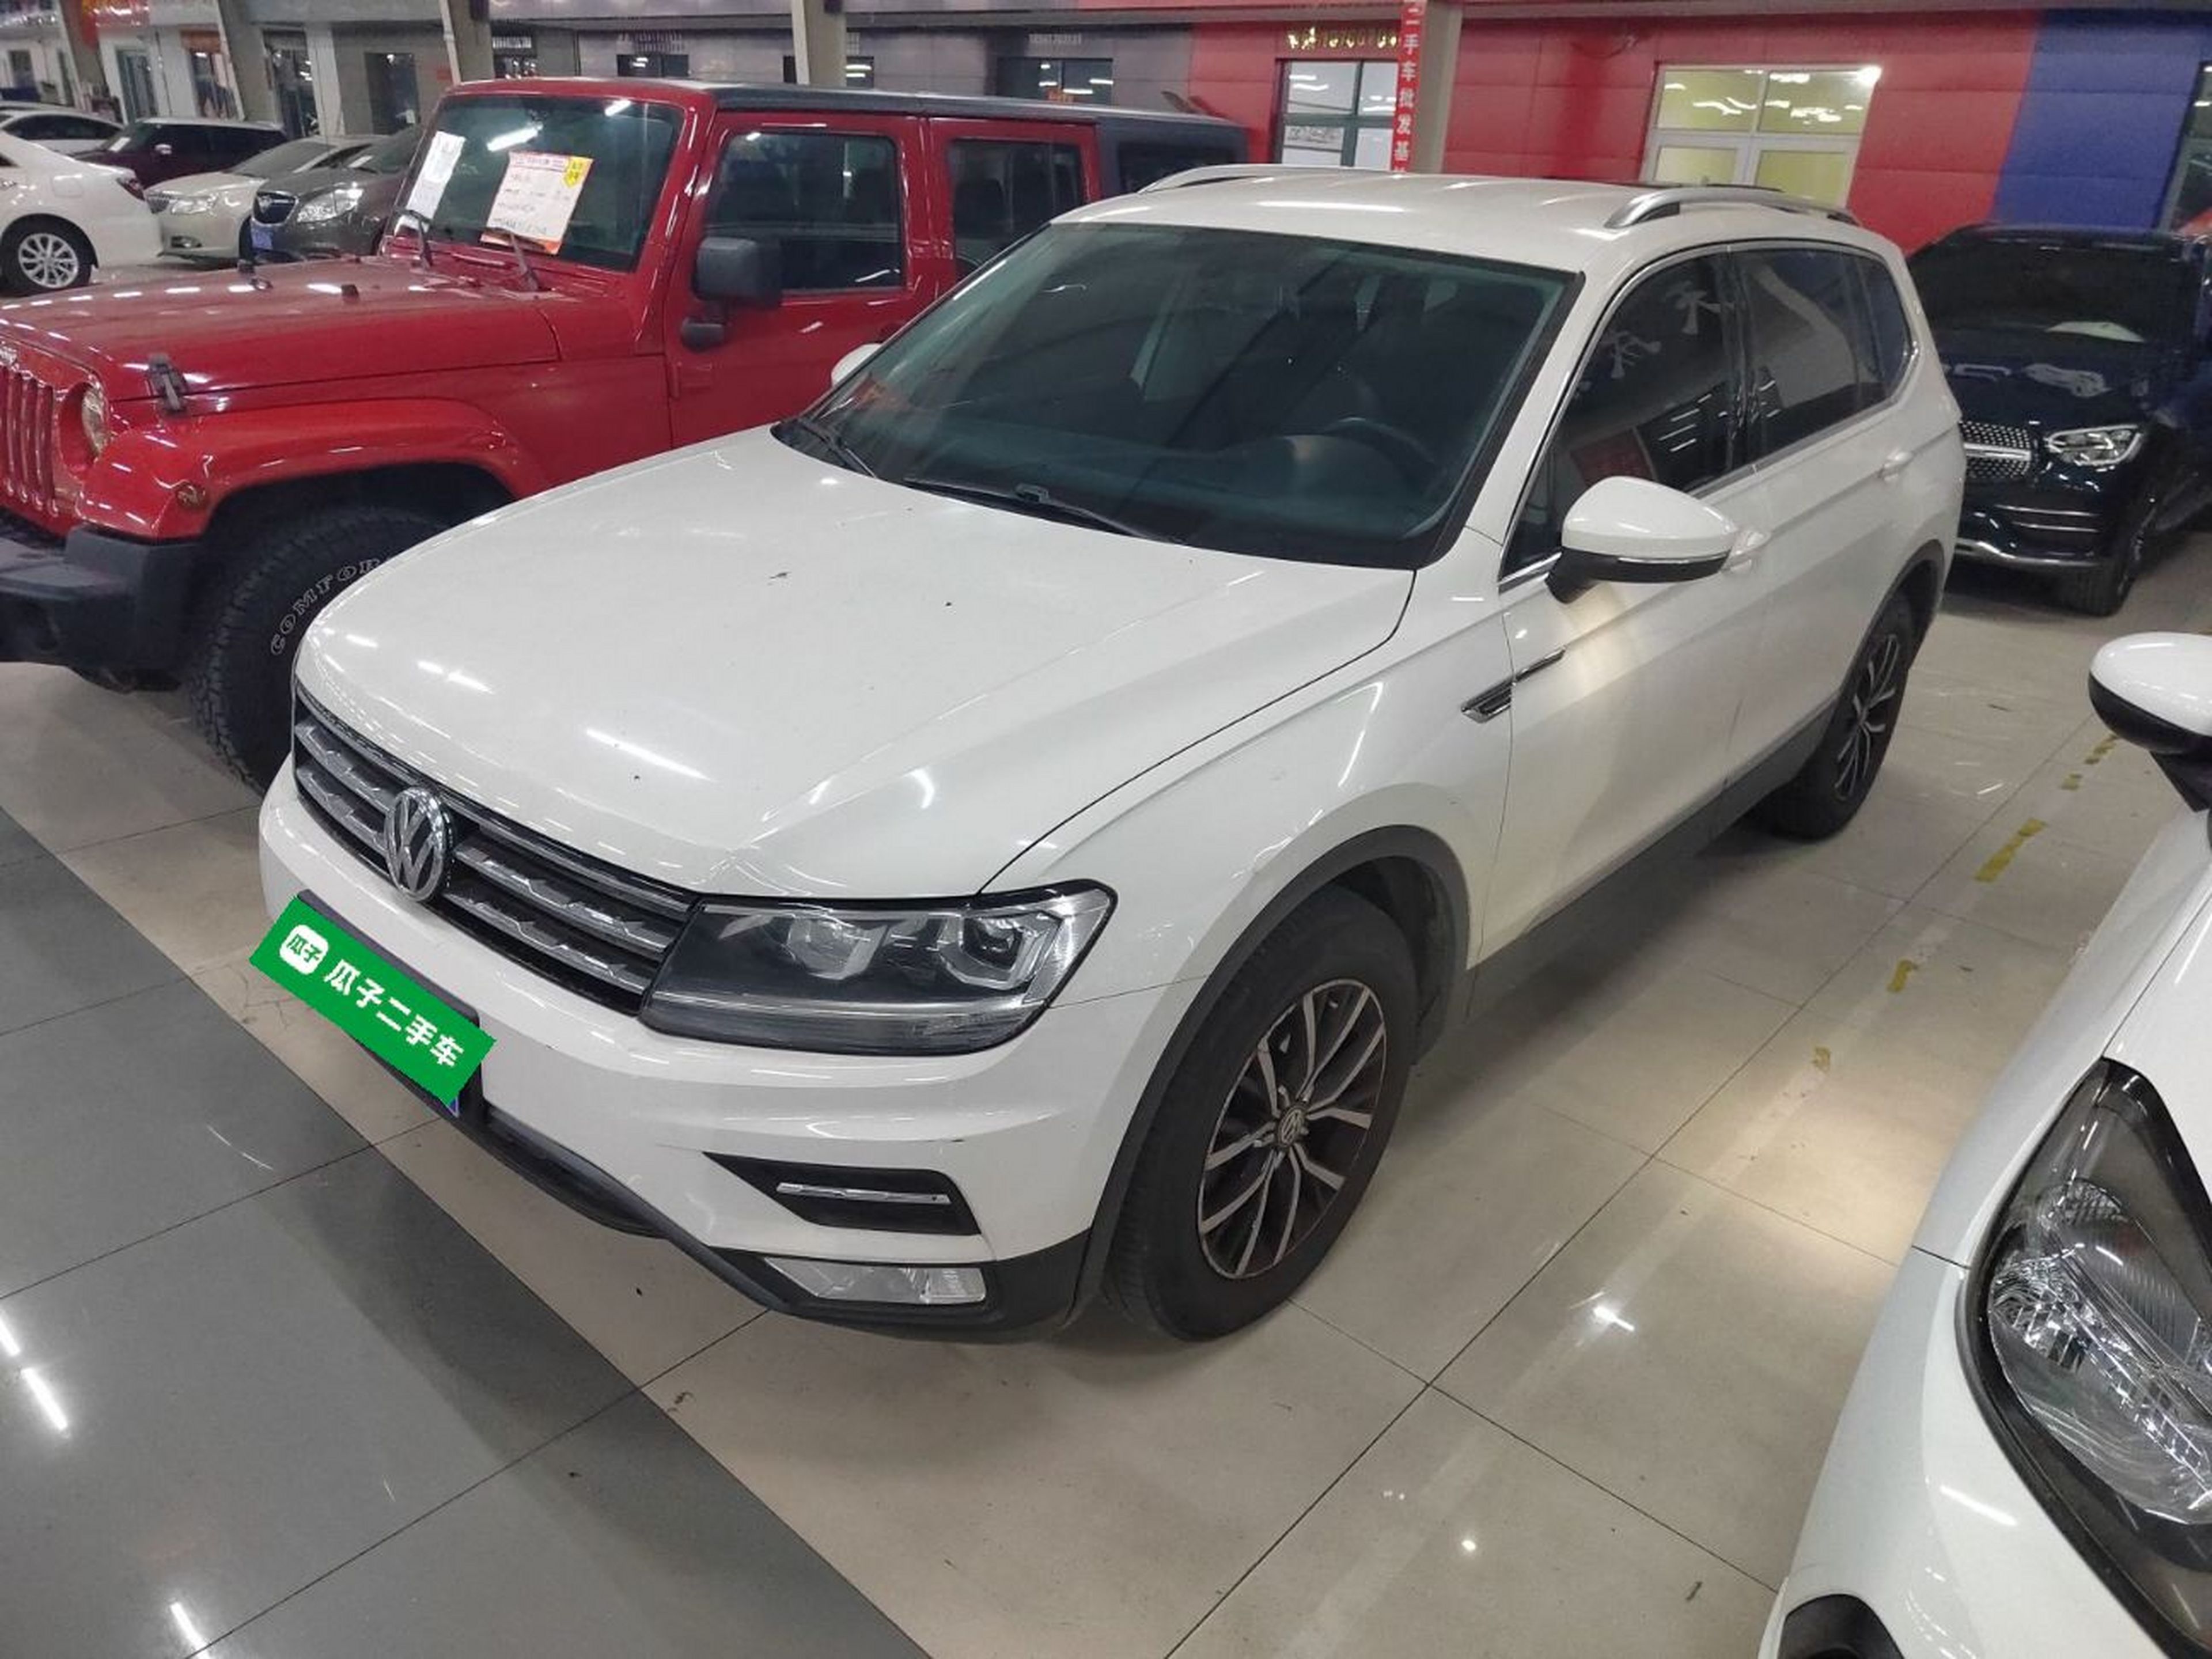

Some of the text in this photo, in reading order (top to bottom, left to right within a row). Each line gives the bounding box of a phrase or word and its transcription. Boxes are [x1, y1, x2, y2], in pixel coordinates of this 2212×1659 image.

[1393, 7, 1421, 172] 二手车批发基
